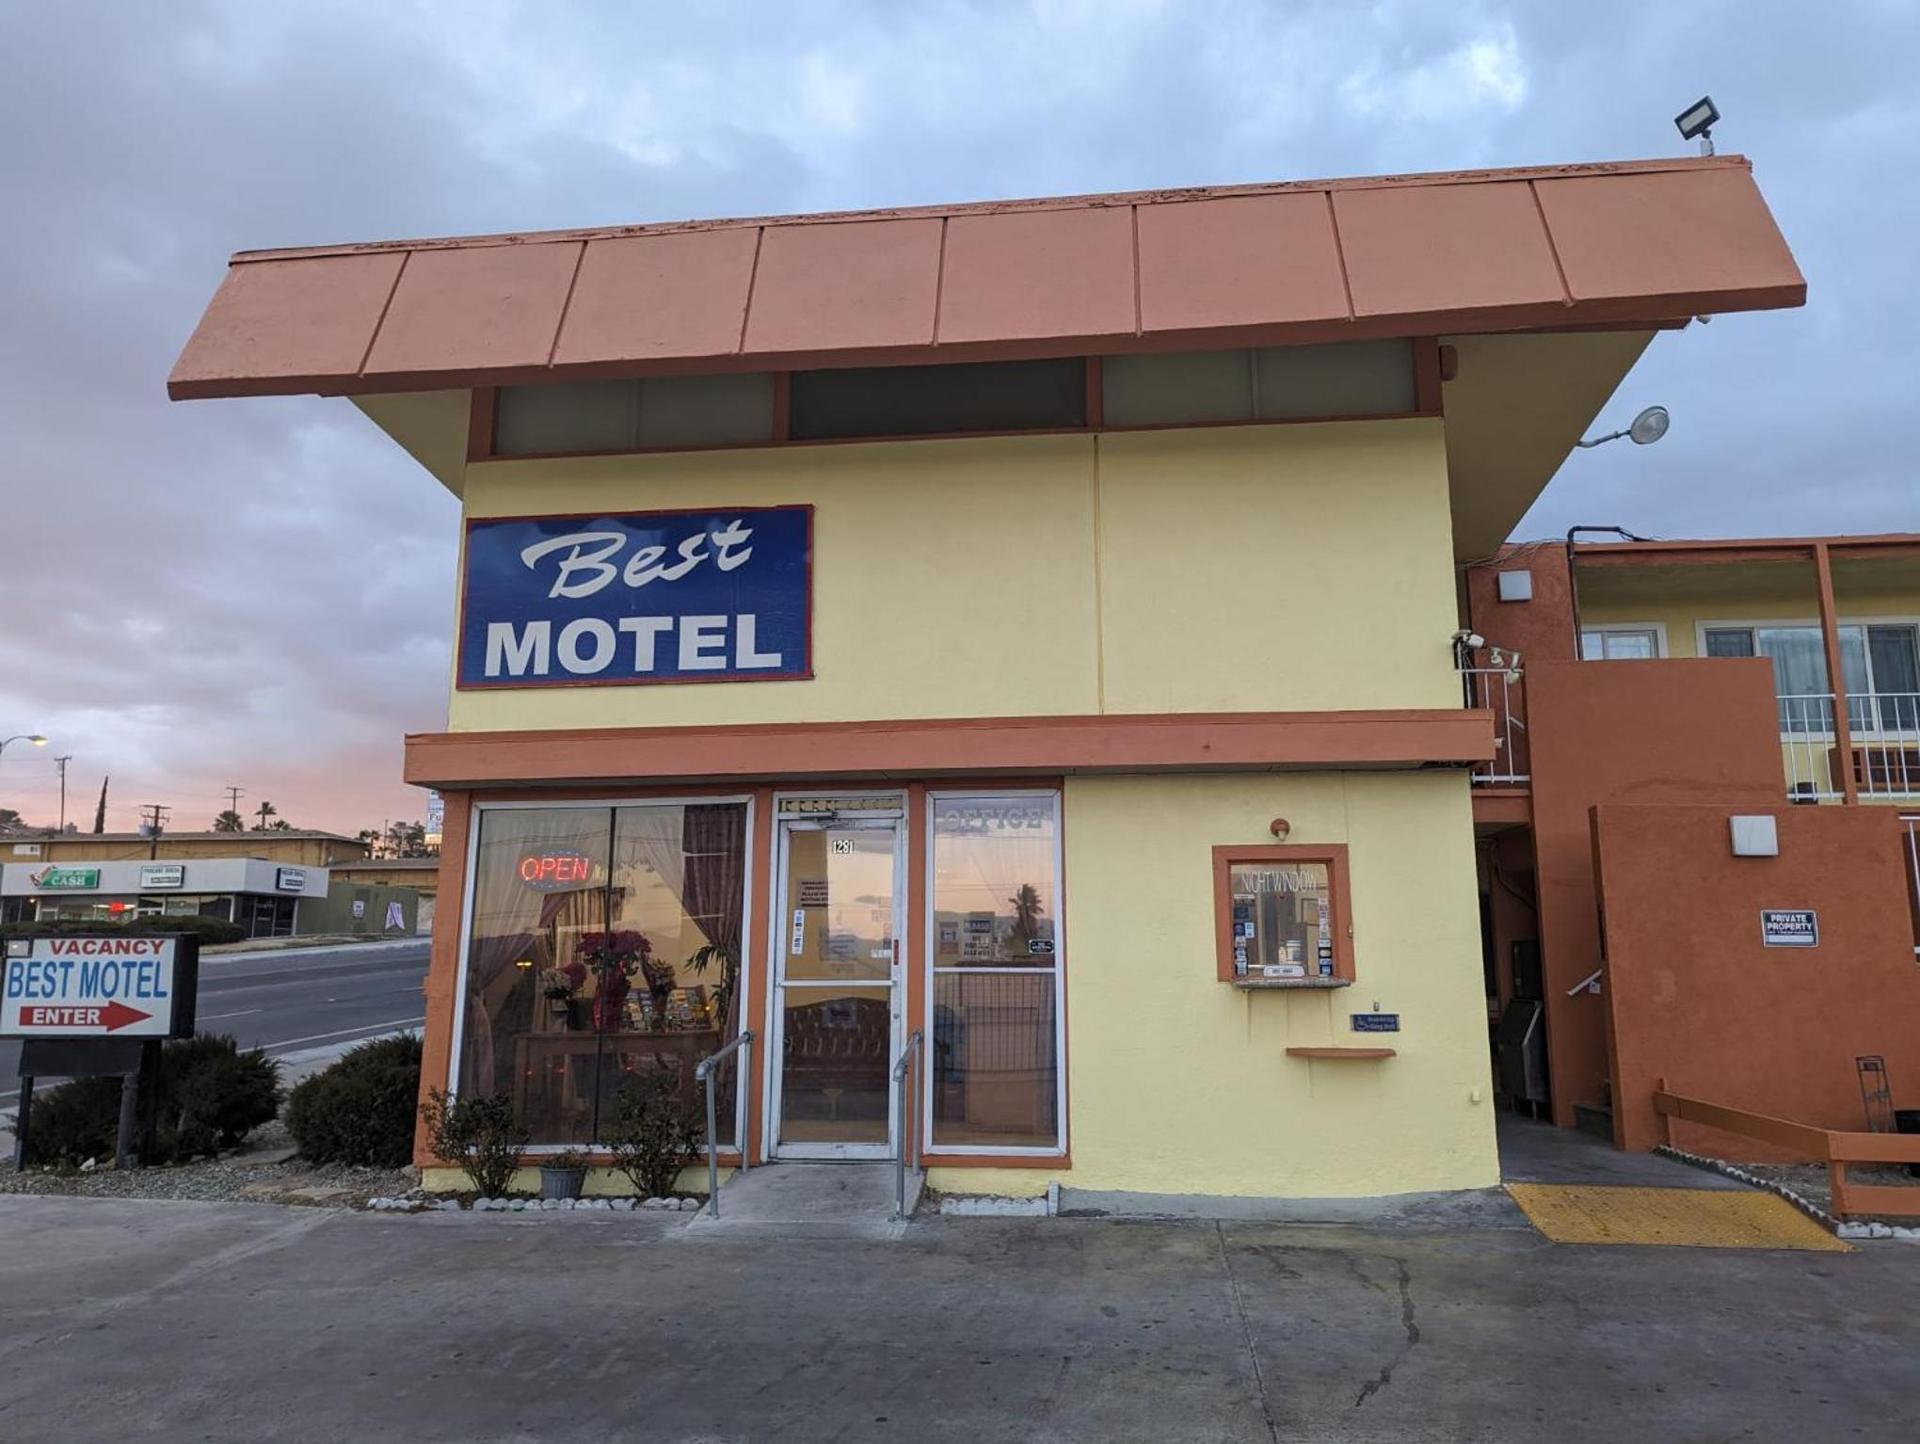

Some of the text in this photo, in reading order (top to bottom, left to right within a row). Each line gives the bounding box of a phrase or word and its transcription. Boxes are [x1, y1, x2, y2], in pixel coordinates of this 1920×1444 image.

[521, 519, 753, 598] Best
[485, 614, 782, 676] MOTEL
[944, 808, 1043, 832] OFFICE
[832, 840, 854, 854] 1281
[521, 857, 589, 881] OPEN
[51, 876, 86, 886] CASH
[1241, 871, 1317, 893] NIGHT WINDOW
[1767, 922, 1812, 930] PROPERTY
[1770, 914, 1807, 922] PRIVATE
[50, 940, 165, 955] VACANCY
[7, 960, 168, 998] BEST MOTEL
[32, 1008, 100, 1025] ENTER
